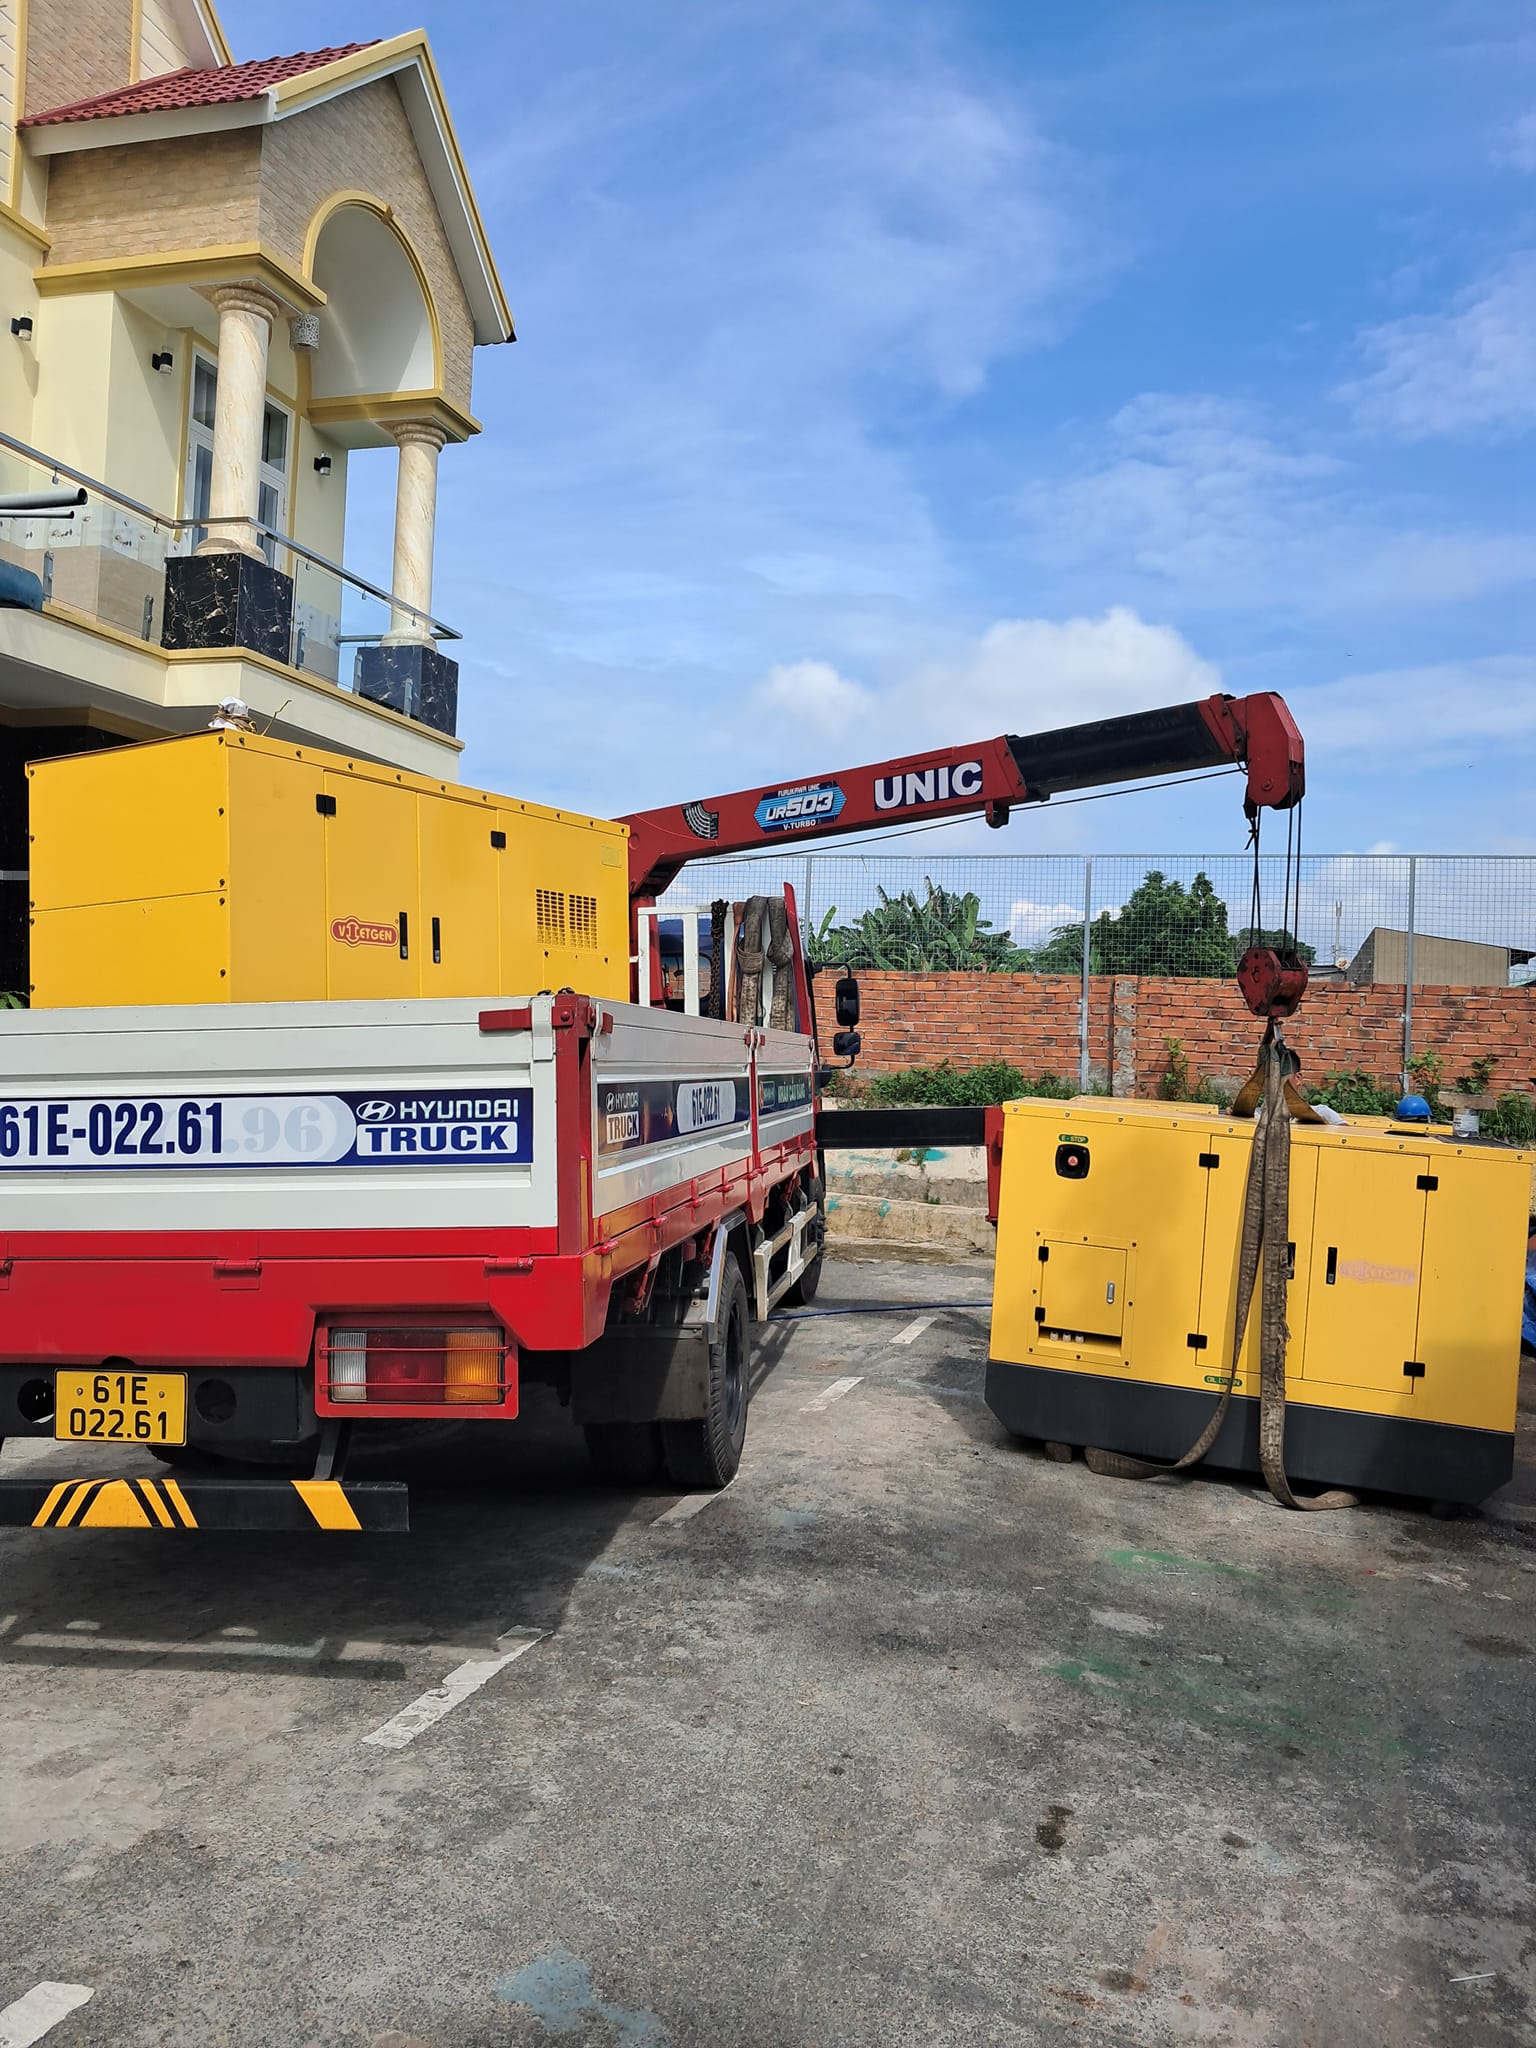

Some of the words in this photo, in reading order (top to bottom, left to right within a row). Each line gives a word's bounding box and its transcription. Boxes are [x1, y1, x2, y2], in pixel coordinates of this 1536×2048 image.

[808, 783, 820, 791] UNIC
[875, 761, 982, 809] UNIC
[765, 790, 834, 821] UR503
[783, 819, 816, 830] V-TURBO
[338, 921, 392, 942] VIETGEN
[400, 1099, 518, 1120] HYUNDAI
[690, 1085, 720, 1127] 61E-022.61
[0, 1102, 222, 1157] 61E-022.61
[365, 1125, 509, 1152] TRUCK
[608, 1114, 638, 1140] TRUCK
[93, 1375, 148, 1405] 61E
[70, 1408, 167, 1440] 022.61
